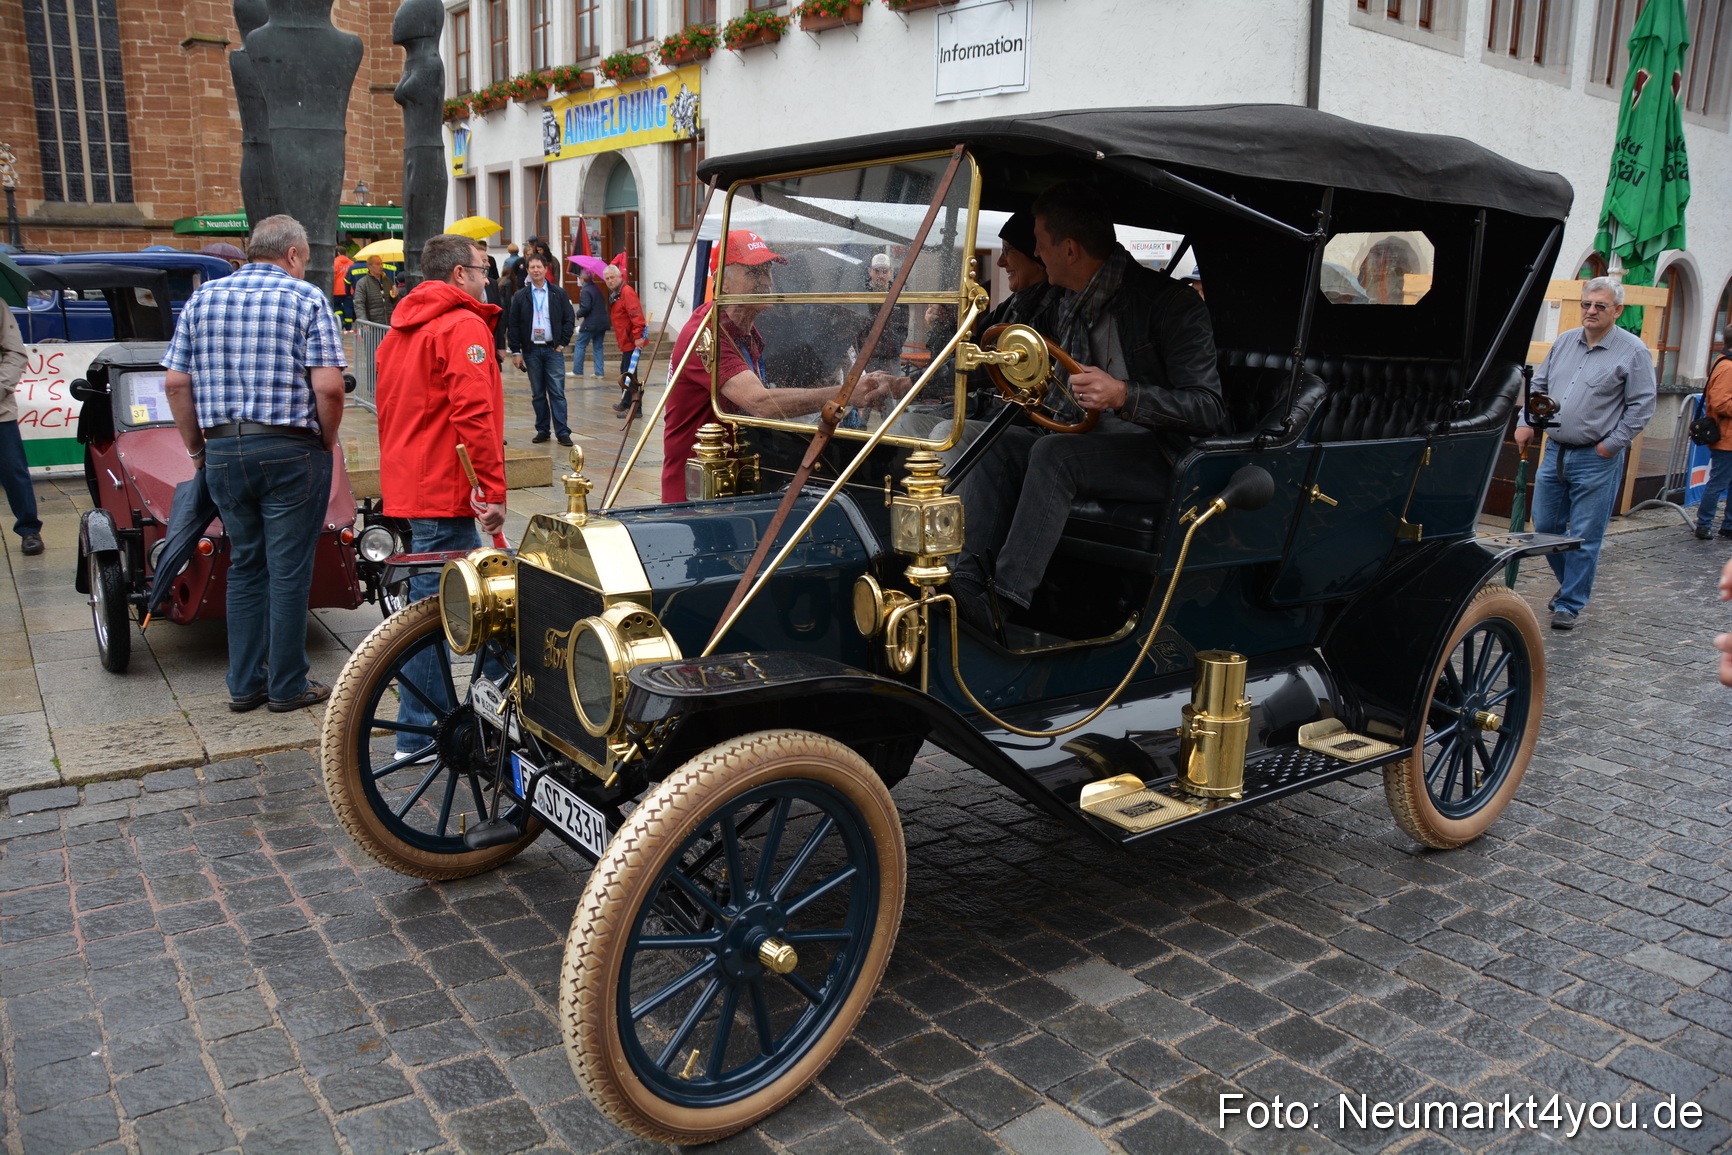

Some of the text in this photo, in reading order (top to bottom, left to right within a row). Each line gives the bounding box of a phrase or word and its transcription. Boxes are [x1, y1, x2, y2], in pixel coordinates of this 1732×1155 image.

[939, 35, 1023, 64] Information
[563, 84, 669, 147] ANMELDUNG
[206, 220, 242, 228] Neumarkter
[340, 220, 383, 230] Neumarkter
[1131, 243, 1165, 251] NEUMARKT
[133, 409, 145, 418] 37
[544, 780, 563, 822] SC
[564, 797, 604, 852] 233H
